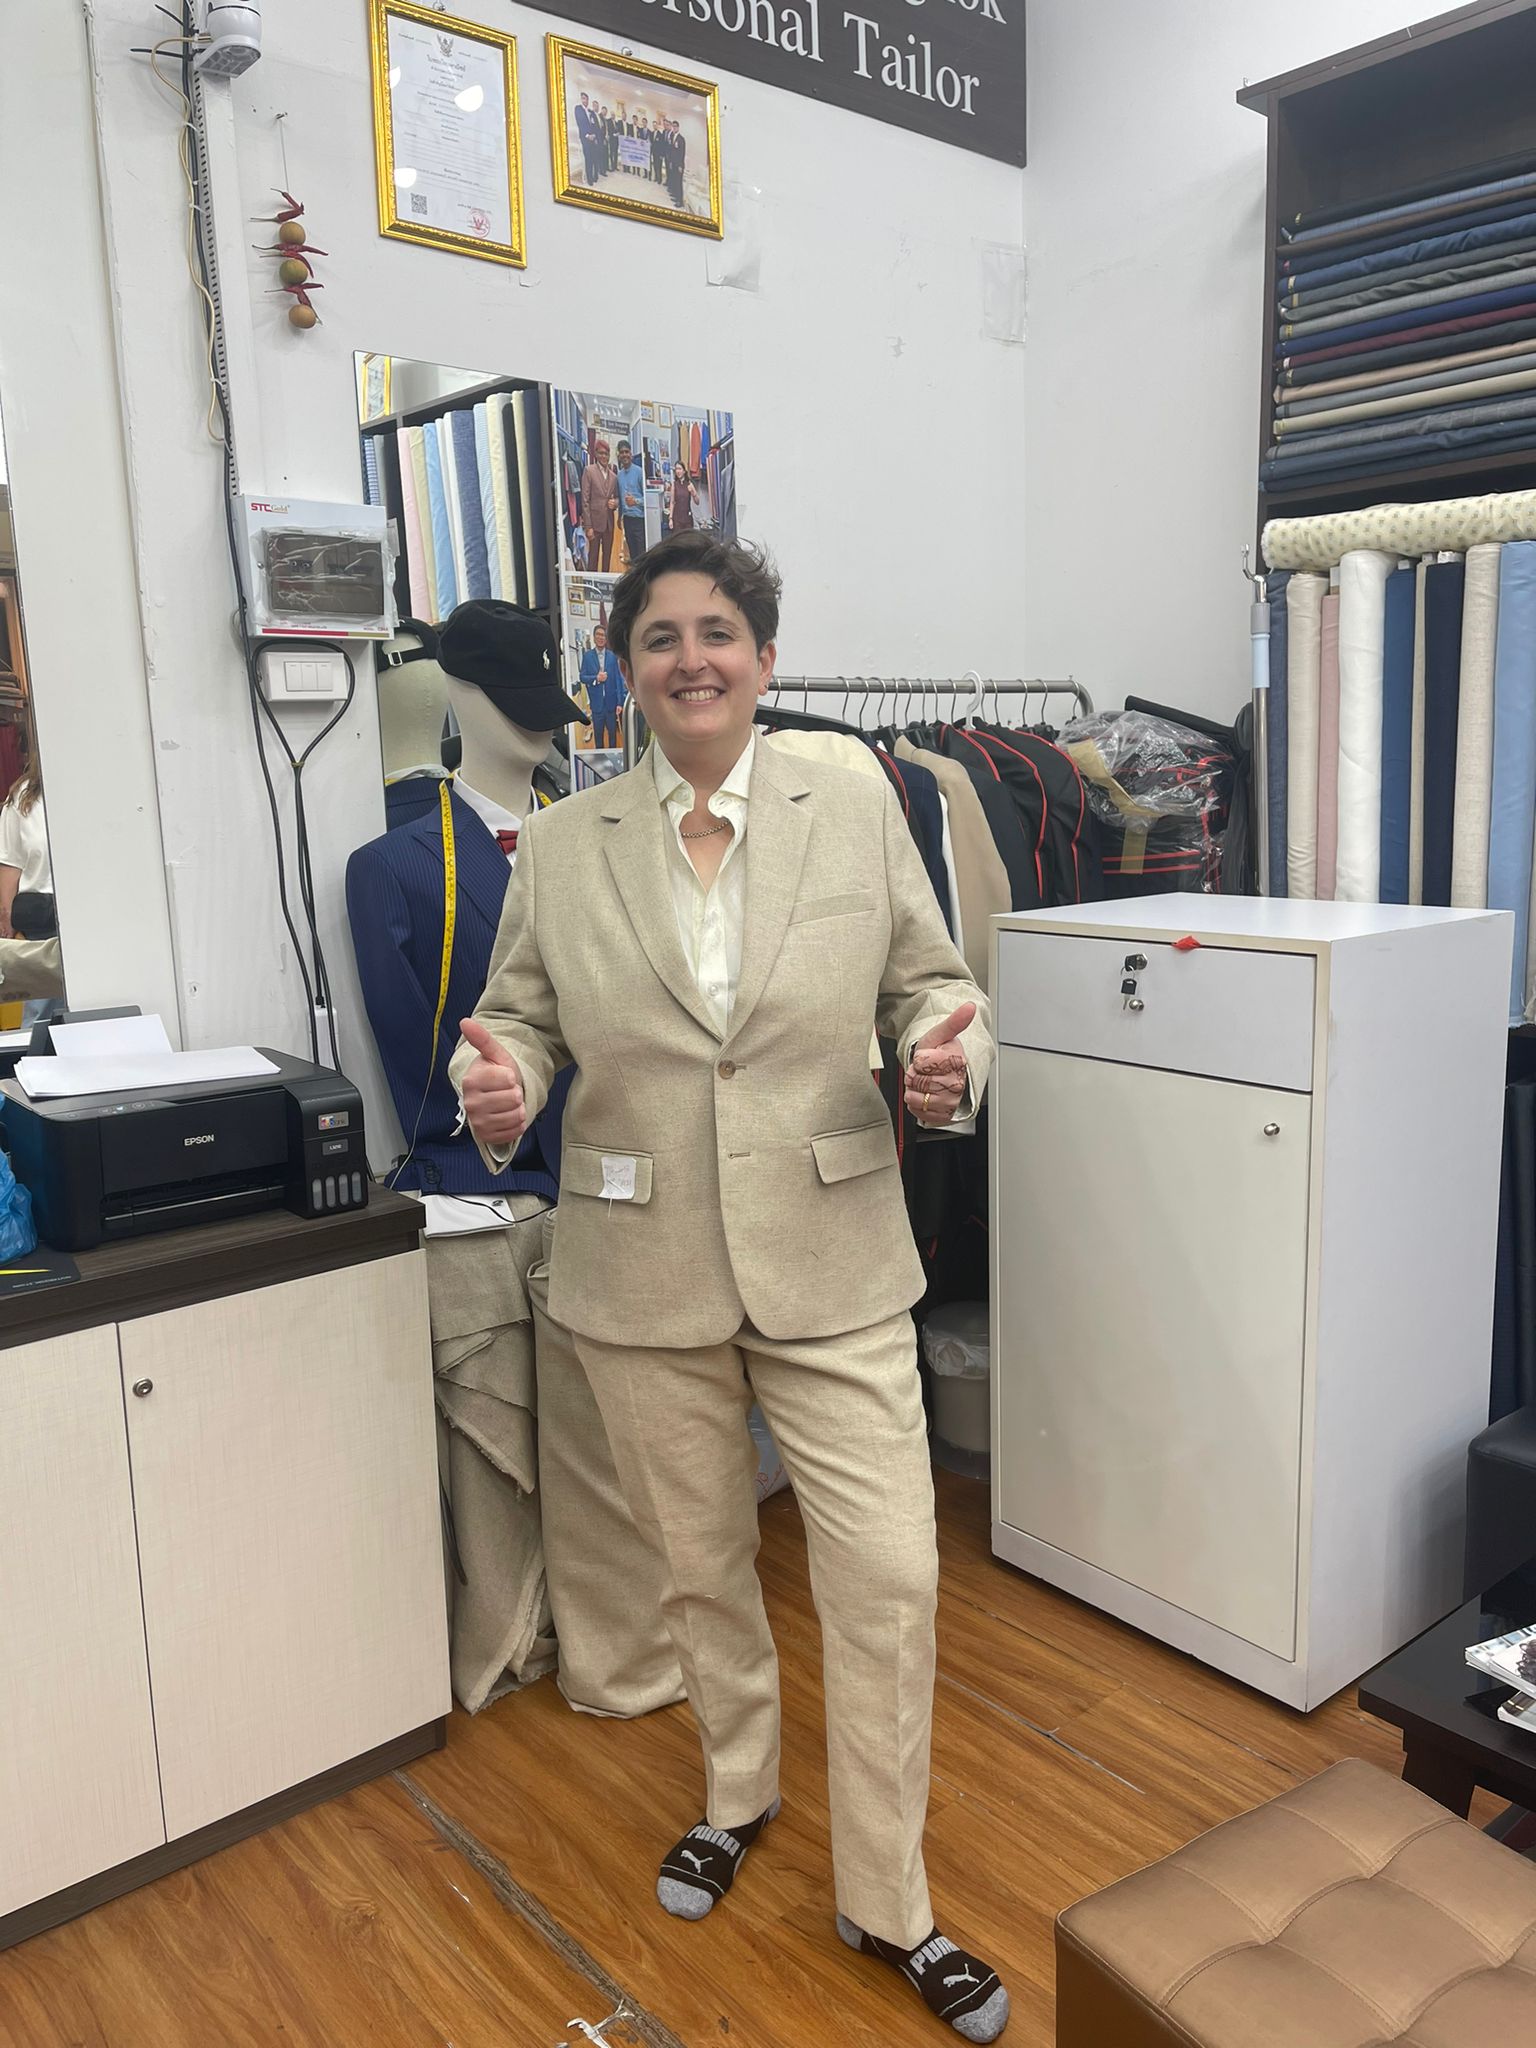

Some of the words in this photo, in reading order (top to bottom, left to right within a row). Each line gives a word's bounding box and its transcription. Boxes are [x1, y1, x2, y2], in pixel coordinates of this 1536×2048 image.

[641, 0, 824, 62] sonal
[843, 11, 980, 116] Tailor
[251, 502, 272, 513] STC
[184, 1134, 215, 1146] EPSON
[909, 1935, 961, 1976] PUM
